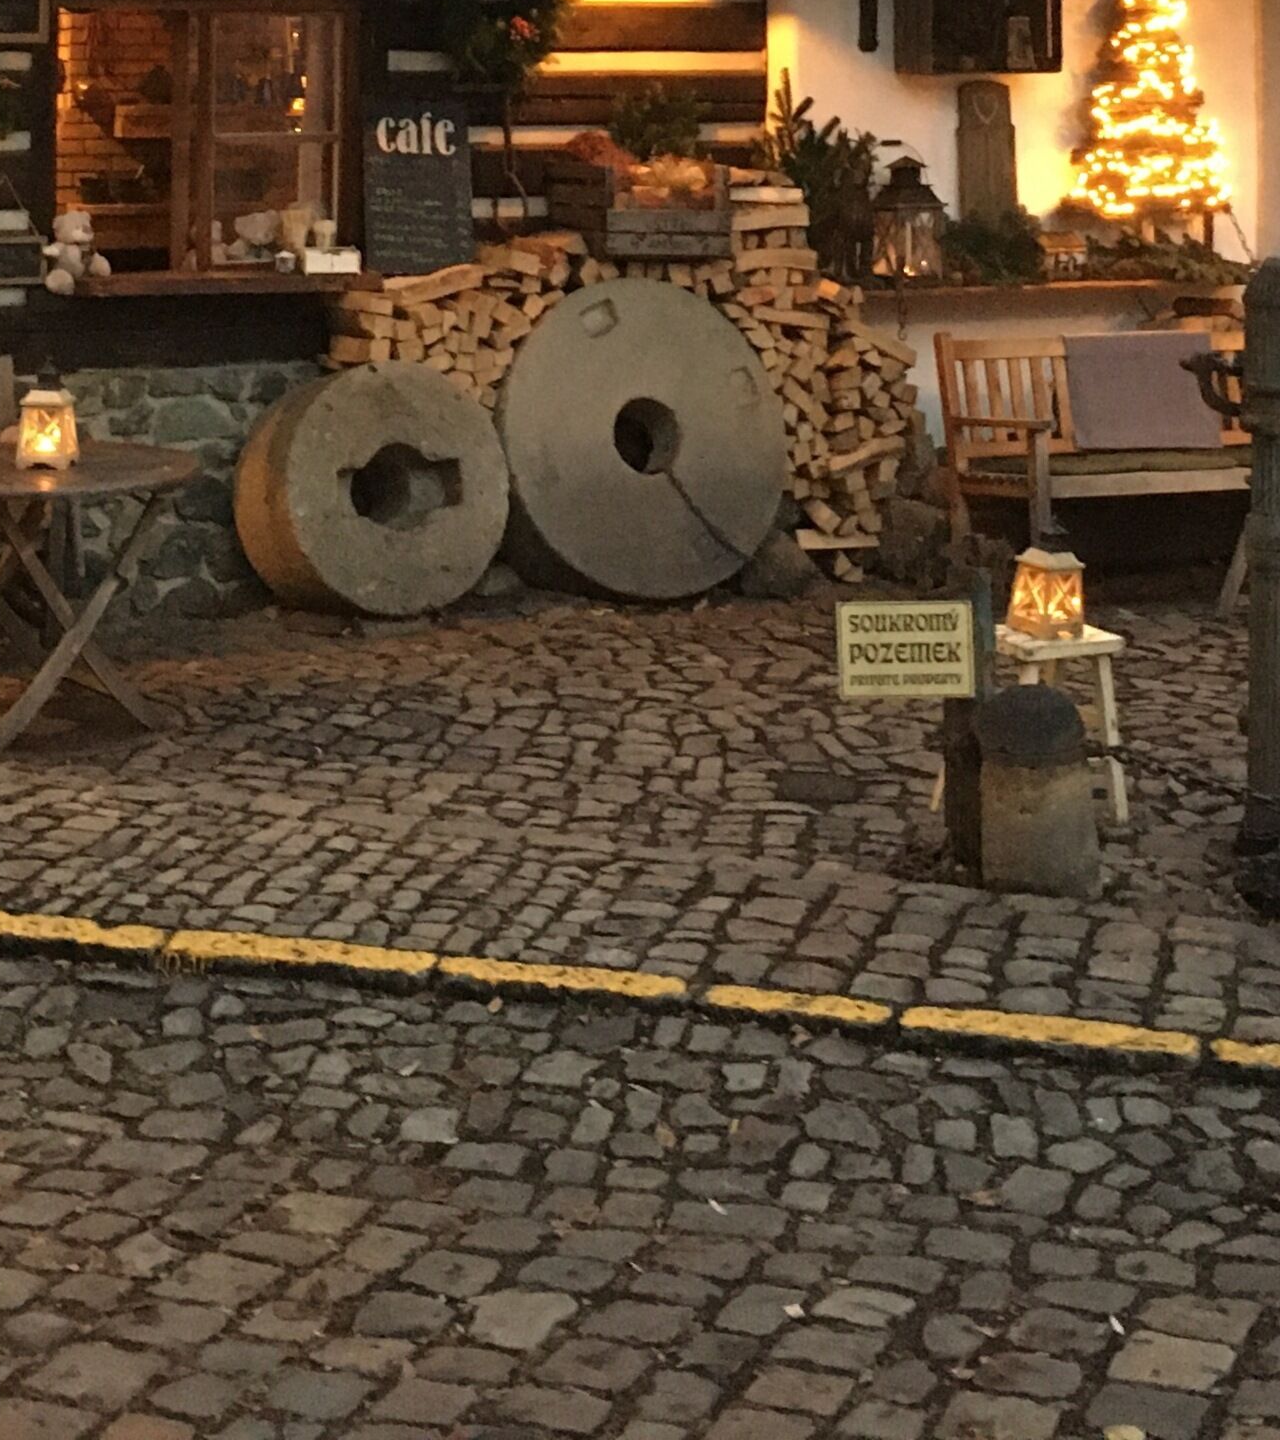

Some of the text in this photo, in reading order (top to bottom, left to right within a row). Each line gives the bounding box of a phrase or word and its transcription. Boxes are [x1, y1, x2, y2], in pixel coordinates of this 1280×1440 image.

[848, 608, 959, 634] SOUKROMÝ
[849, 642, 962, 665] POZEMEK
[848, 673, 963, 687] PRIVATE PROPERTY
